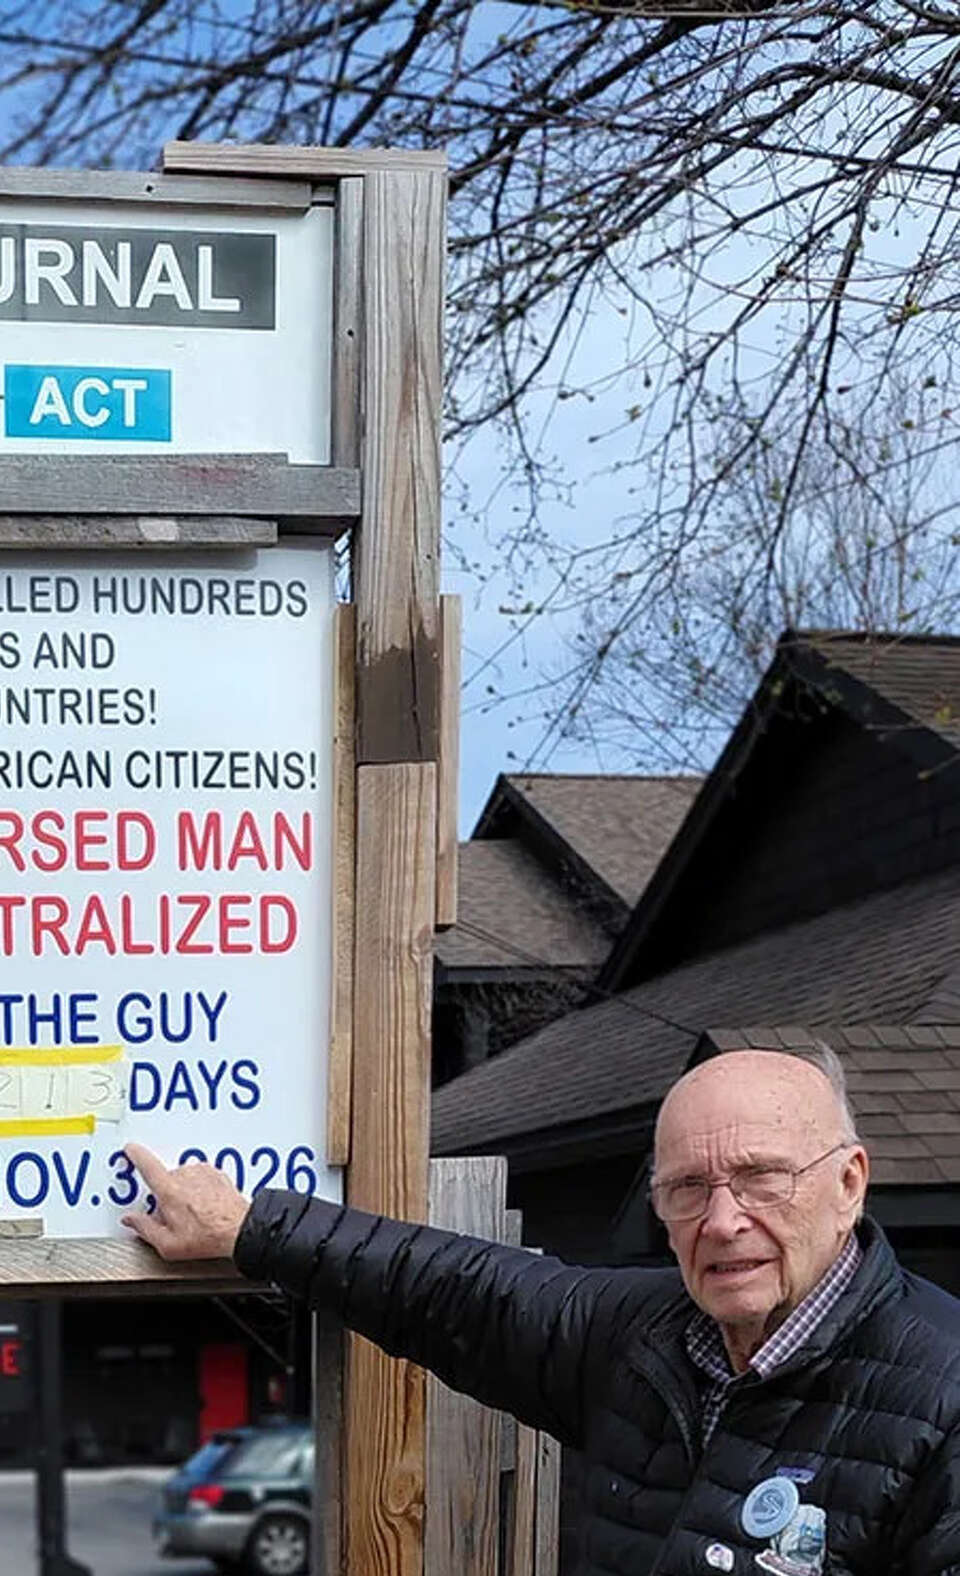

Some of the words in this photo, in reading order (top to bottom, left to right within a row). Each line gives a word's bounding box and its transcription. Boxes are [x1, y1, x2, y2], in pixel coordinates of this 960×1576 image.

[30, 377, 146, 429] ACT
[93, 576, 307, 618] HUNDREDS
[33, 632, 114, 668] AND
[125, 750, 316, 789] CITIZENS!
[178, 811, 311, 870] MAN
[116, 990, 228, 1045] GUY
[129, 1059, 261, 1111] DAYS
